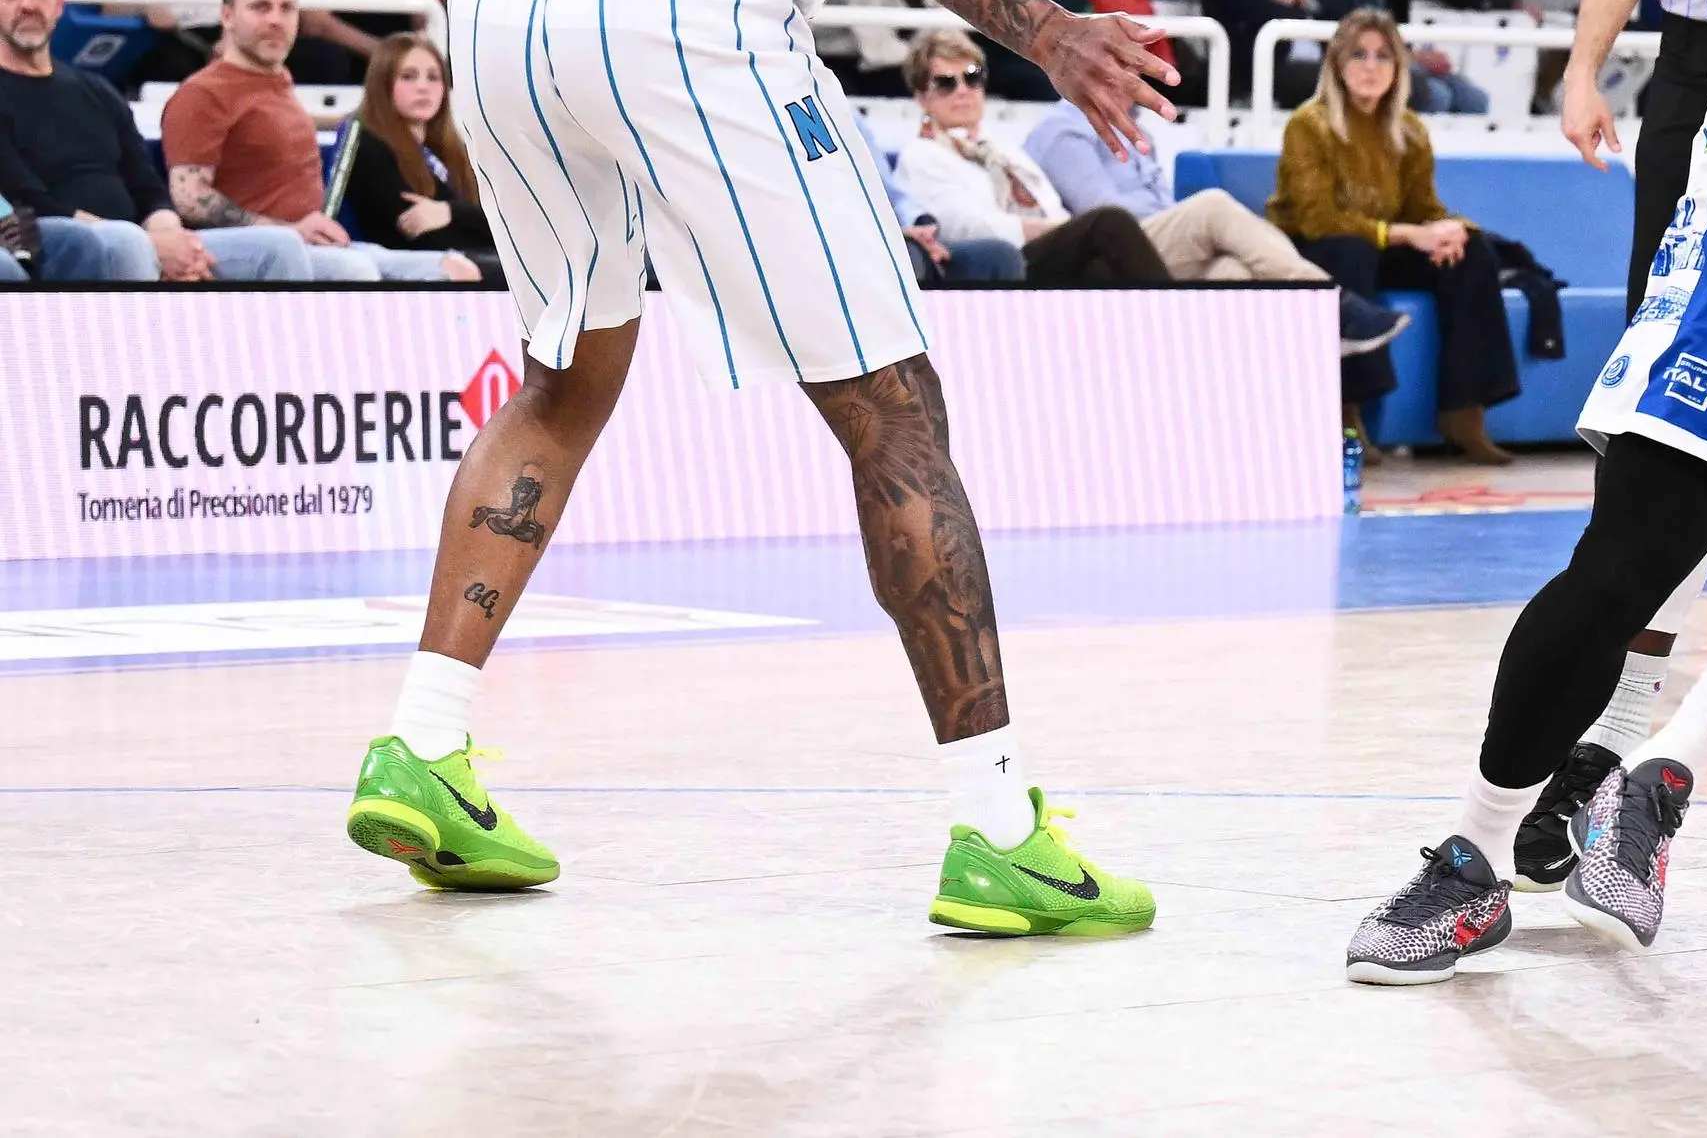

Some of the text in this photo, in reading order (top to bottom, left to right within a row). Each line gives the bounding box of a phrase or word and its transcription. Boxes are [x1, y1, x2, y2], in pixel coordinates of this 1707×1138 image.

[784, 94, 838, 162] N
[78, 389, 464, 471] RACCORDERIE
[166, 486, 185, 520] di
[190, 486, 289, 519] Precisione
[294, 481, 323, 516] dal
[327, 484, 374, 515] 1979
